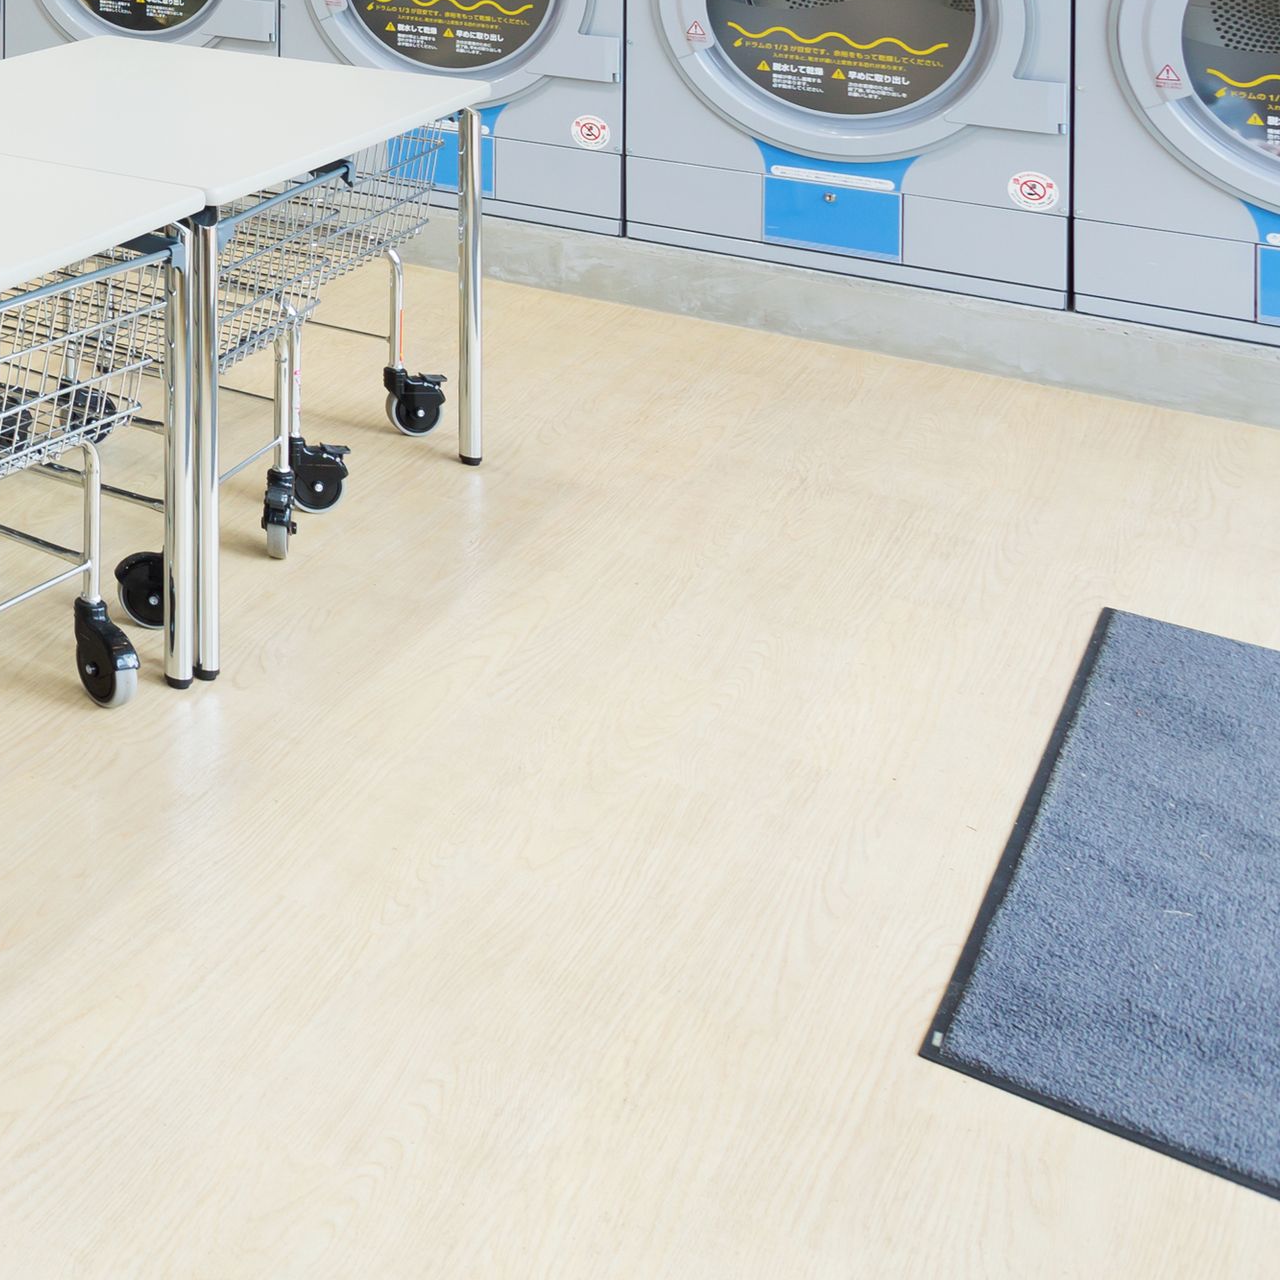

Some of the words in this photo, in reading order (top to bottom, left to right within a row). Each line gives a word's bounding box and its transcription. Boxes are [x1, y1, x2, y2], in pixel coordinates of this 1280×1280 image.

[456, 29, 505, 43] 早めに取り出し
[774, 43, 789, 52] 1/3
[773, 62, 824, 76] 脱水して乾燥
[848, 70, 911, 86] 早めに取り出し
